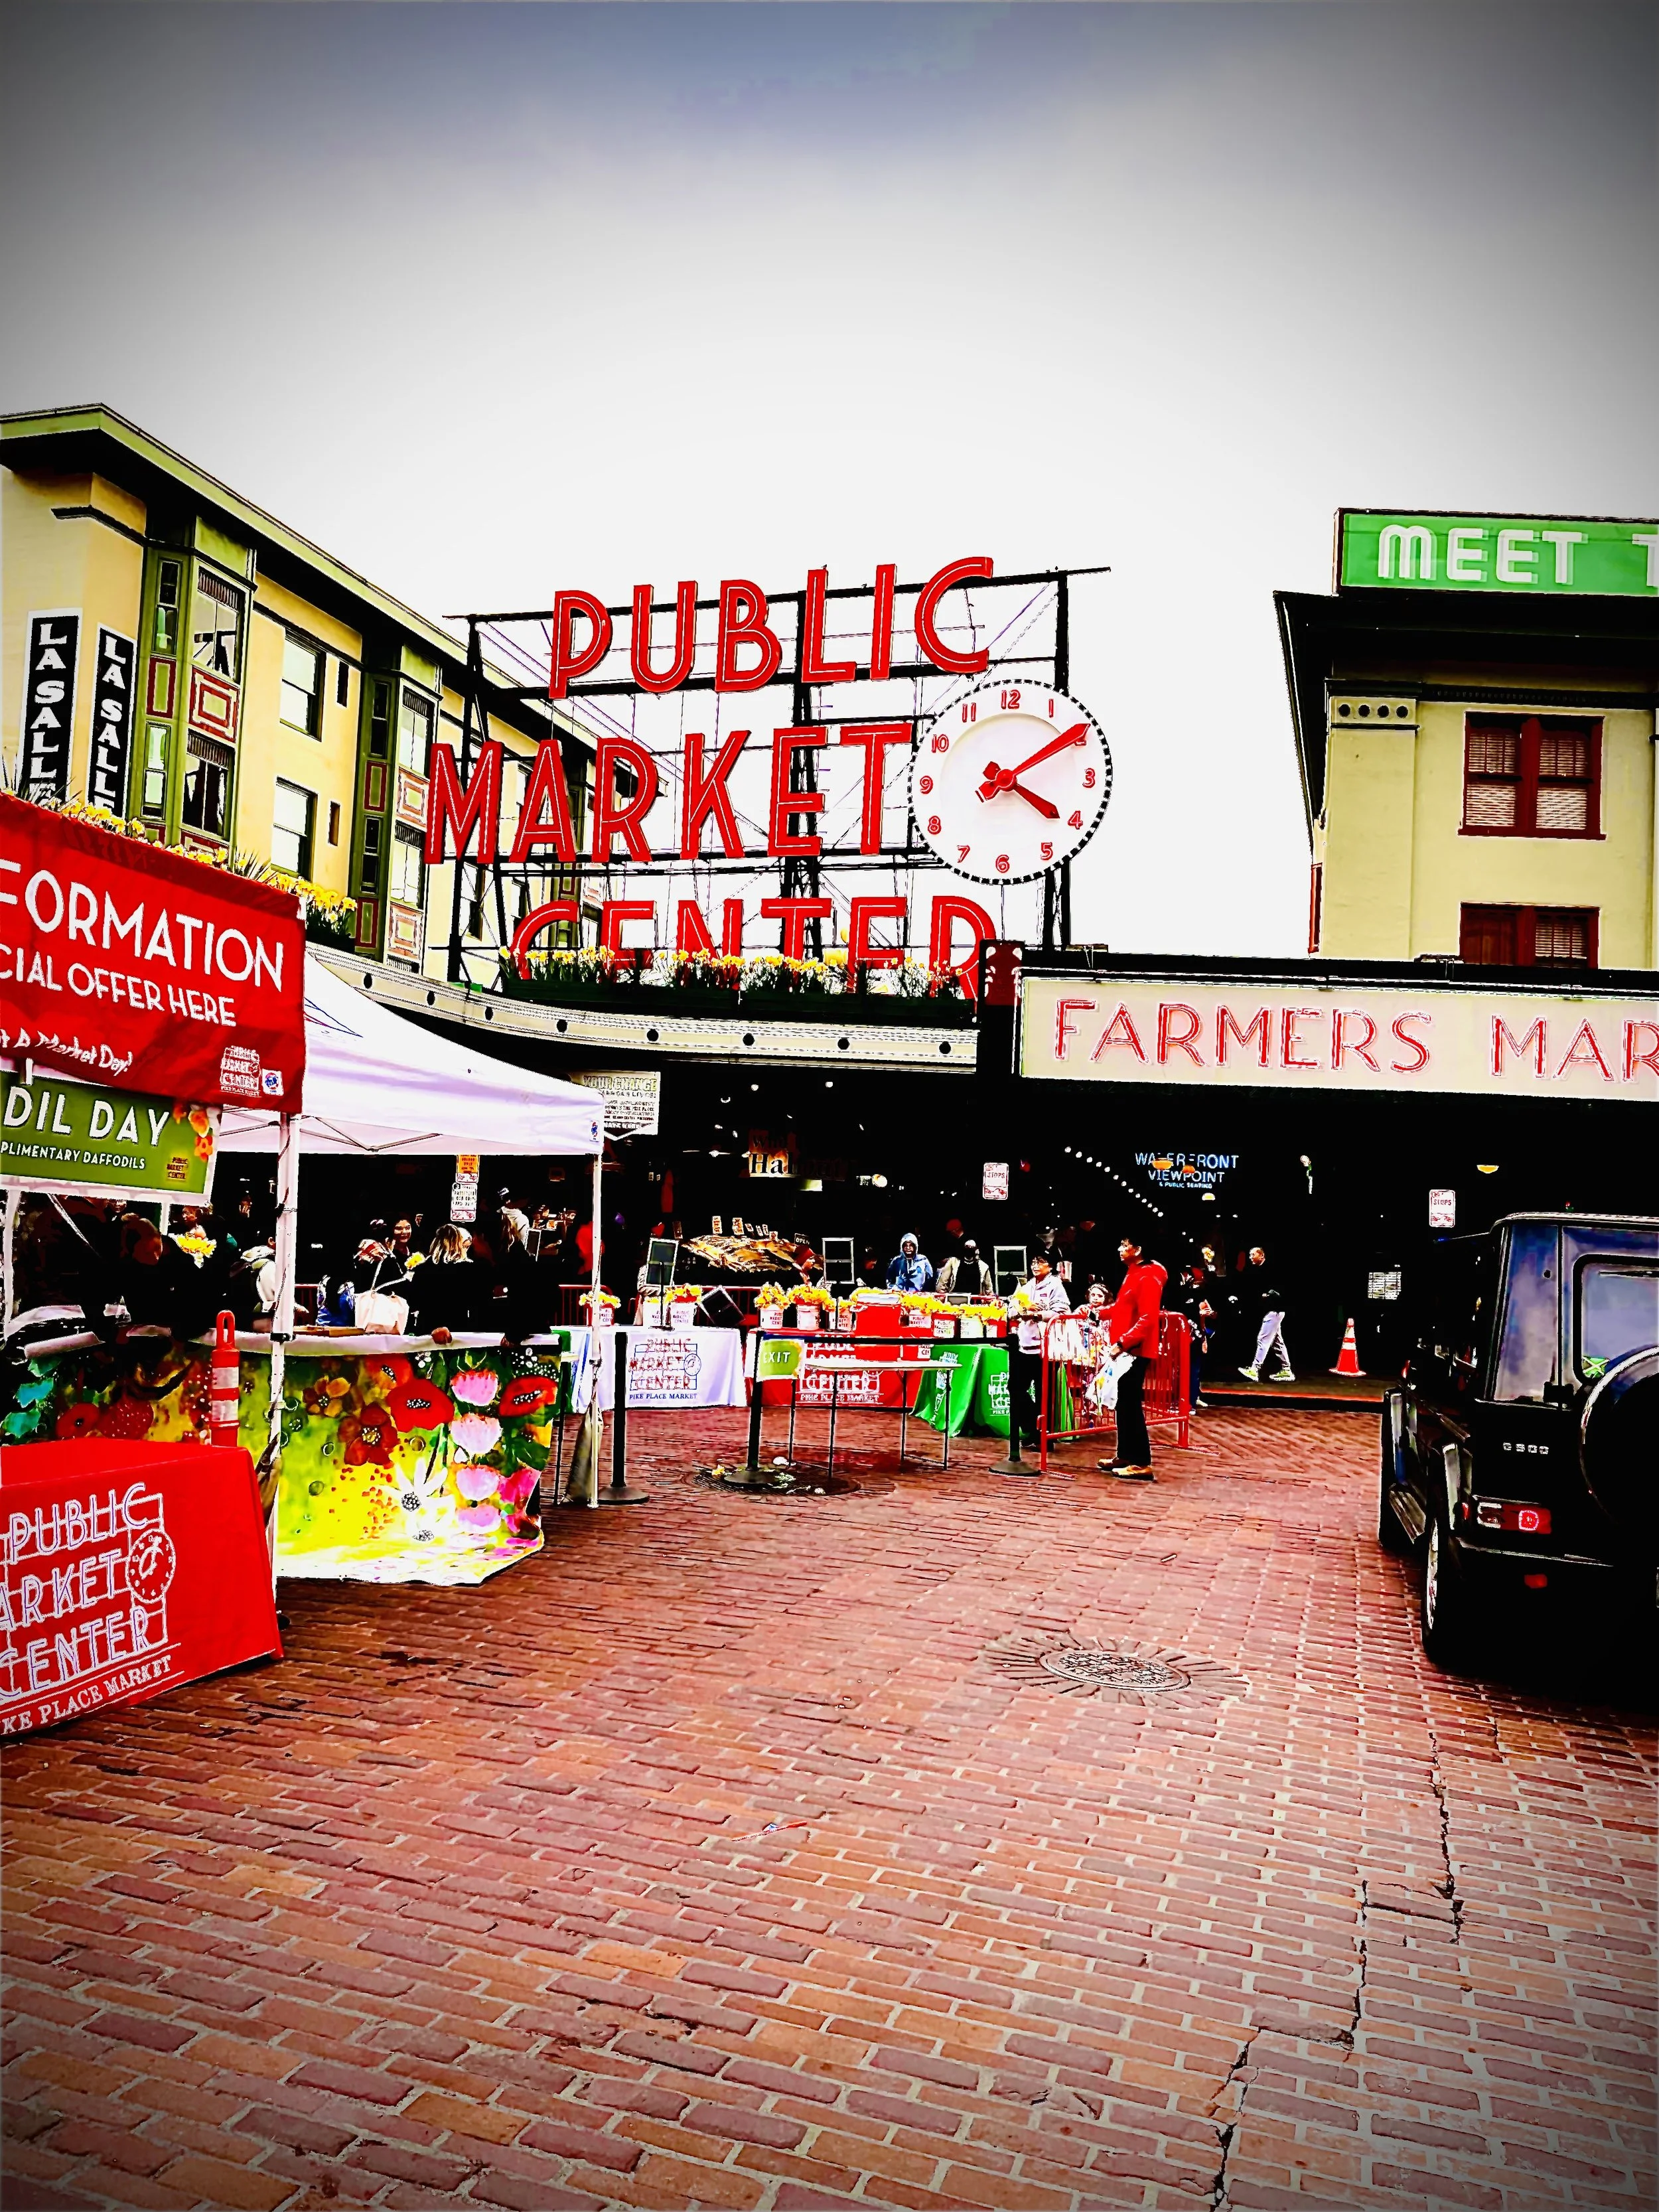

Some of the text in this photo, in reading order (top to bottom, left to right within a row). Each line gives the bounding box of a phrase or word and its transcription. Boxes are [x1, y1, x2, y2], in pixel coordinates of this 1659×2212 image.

[1378, 524, 1586, 585] MEET
[549, 557, 993, 699] PUBLIC
[35, 623, 67, 670] LA
[102, 635, 126, 690] LA
[1000, 690, 1020, 709] 12
[1048, 699, 1054, 717] 1
[962, 703, 977, 721] 11
[931, 735, 949, 754] 10
[919, 776, 934, 794] 9
[1082, 769, 1096, 788] 3
[425, 723, 913, 863] MARKET
[927, 816, 942, 835] 8
[1067, 811, 1084, 830] 4
[956, 845, 970, 863] 7
[1040, 842, 1053, 860] 5
[996, 855, 1009, 873] 6
[508, 896, 997, 997] CENTER
[68, 963, 165, 1011] OFFER
[167, 984, 236, 1027] HERE
[1054, 999, 1659, 1083] FARMERS MAR
[35, 1031, 97, 1065] Market
[99, 1043, 133, 1076] Day!
[584, 1075, 657, 1092] YOUR CHANGE
[3, 1086, 170, 1147] DIL DAY
[0, 1141, 145, 1170] PLIMENTARY DAFFODILS
[1135, 1152, 1240, 1169] WAERFRONT
[1148, 1169, 1225, 1183] VIEWPOINT
[646, 1339, 691, 1353] PUBLIC
[628, 1356, 683, 1372] MARKET
[764, 1352, 791, 1363] EXIT
[635, 1375, 691, 1390] CENTER
[9, 1482, 148, 1565] PUBLIC
[0, 1605, 150, 1702] CENTER
[38, 1685, 104, 1724] PLACE
[103, 1655, 172, 1697] MARKET
